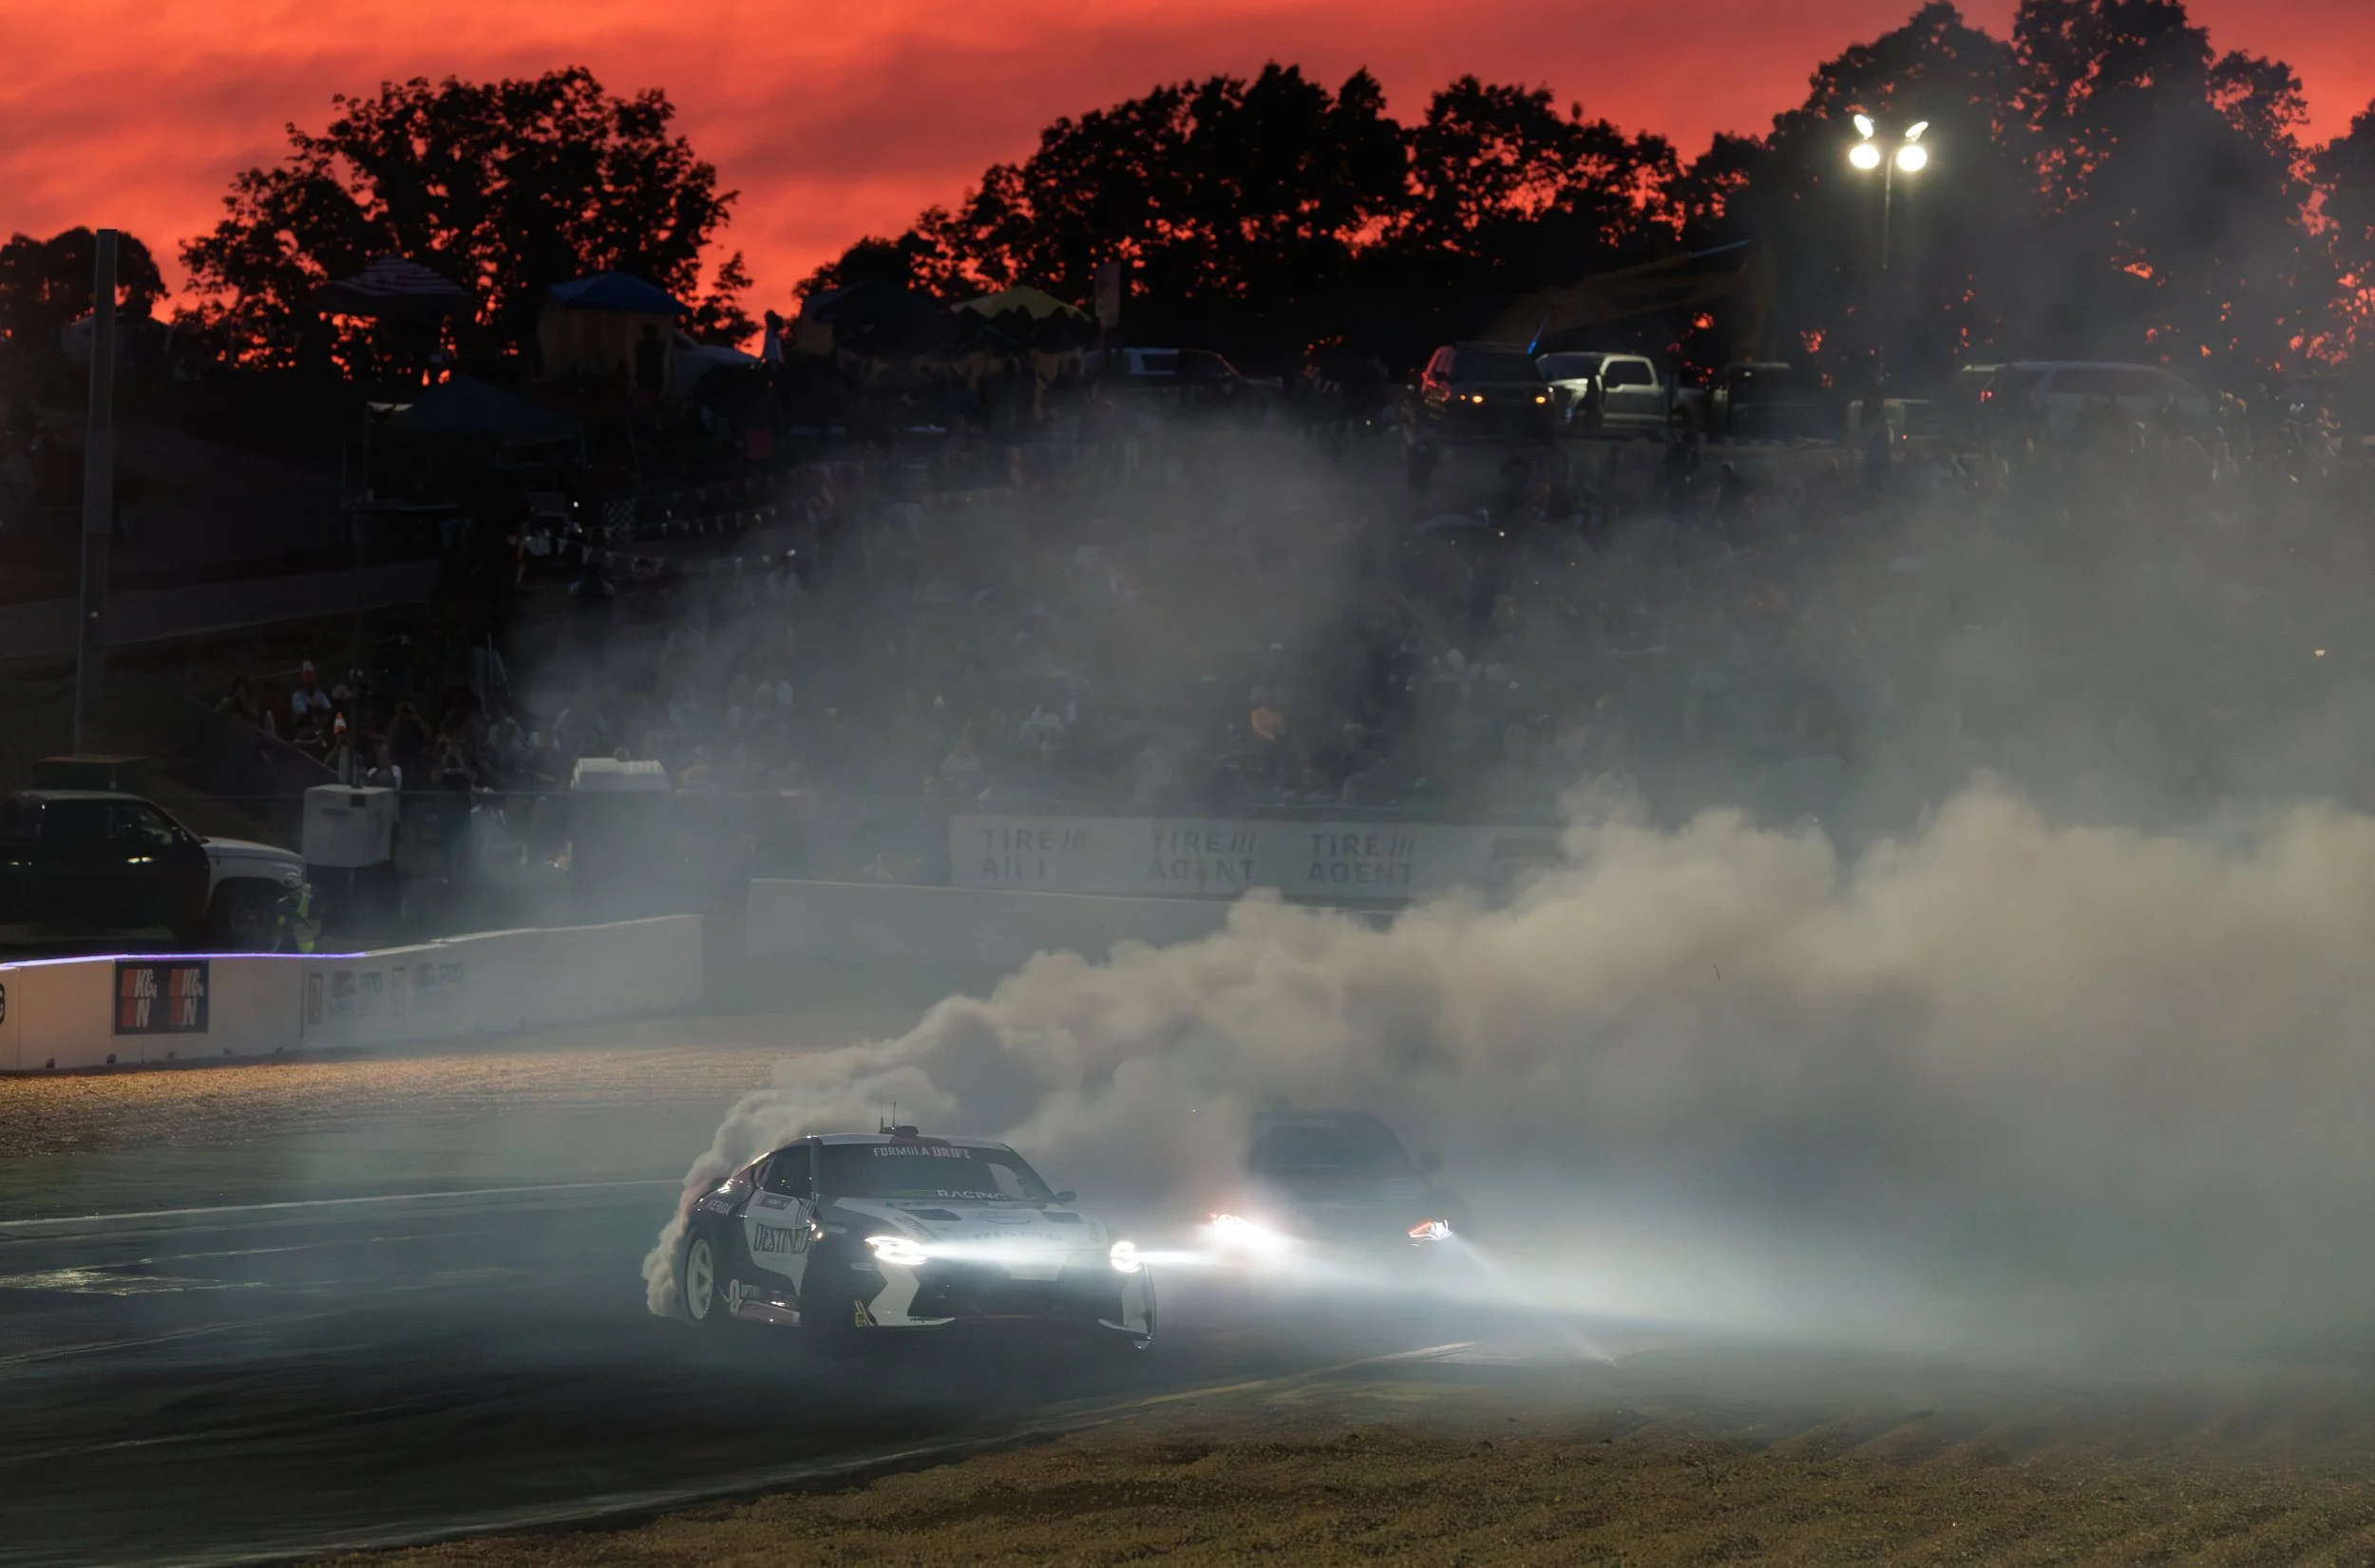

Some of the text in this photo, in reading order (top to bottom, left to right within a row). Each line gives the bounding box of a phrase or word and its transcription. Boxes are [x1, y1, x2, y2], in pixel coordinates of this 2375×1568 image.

[1150, 830, 1222, 854] TIRE
[1309, 833, 1380, 857] TIRE
[1306, 861, 1415, 884] AGENT
[873, 1145, 973, 1160] FORMULA DRIFT
